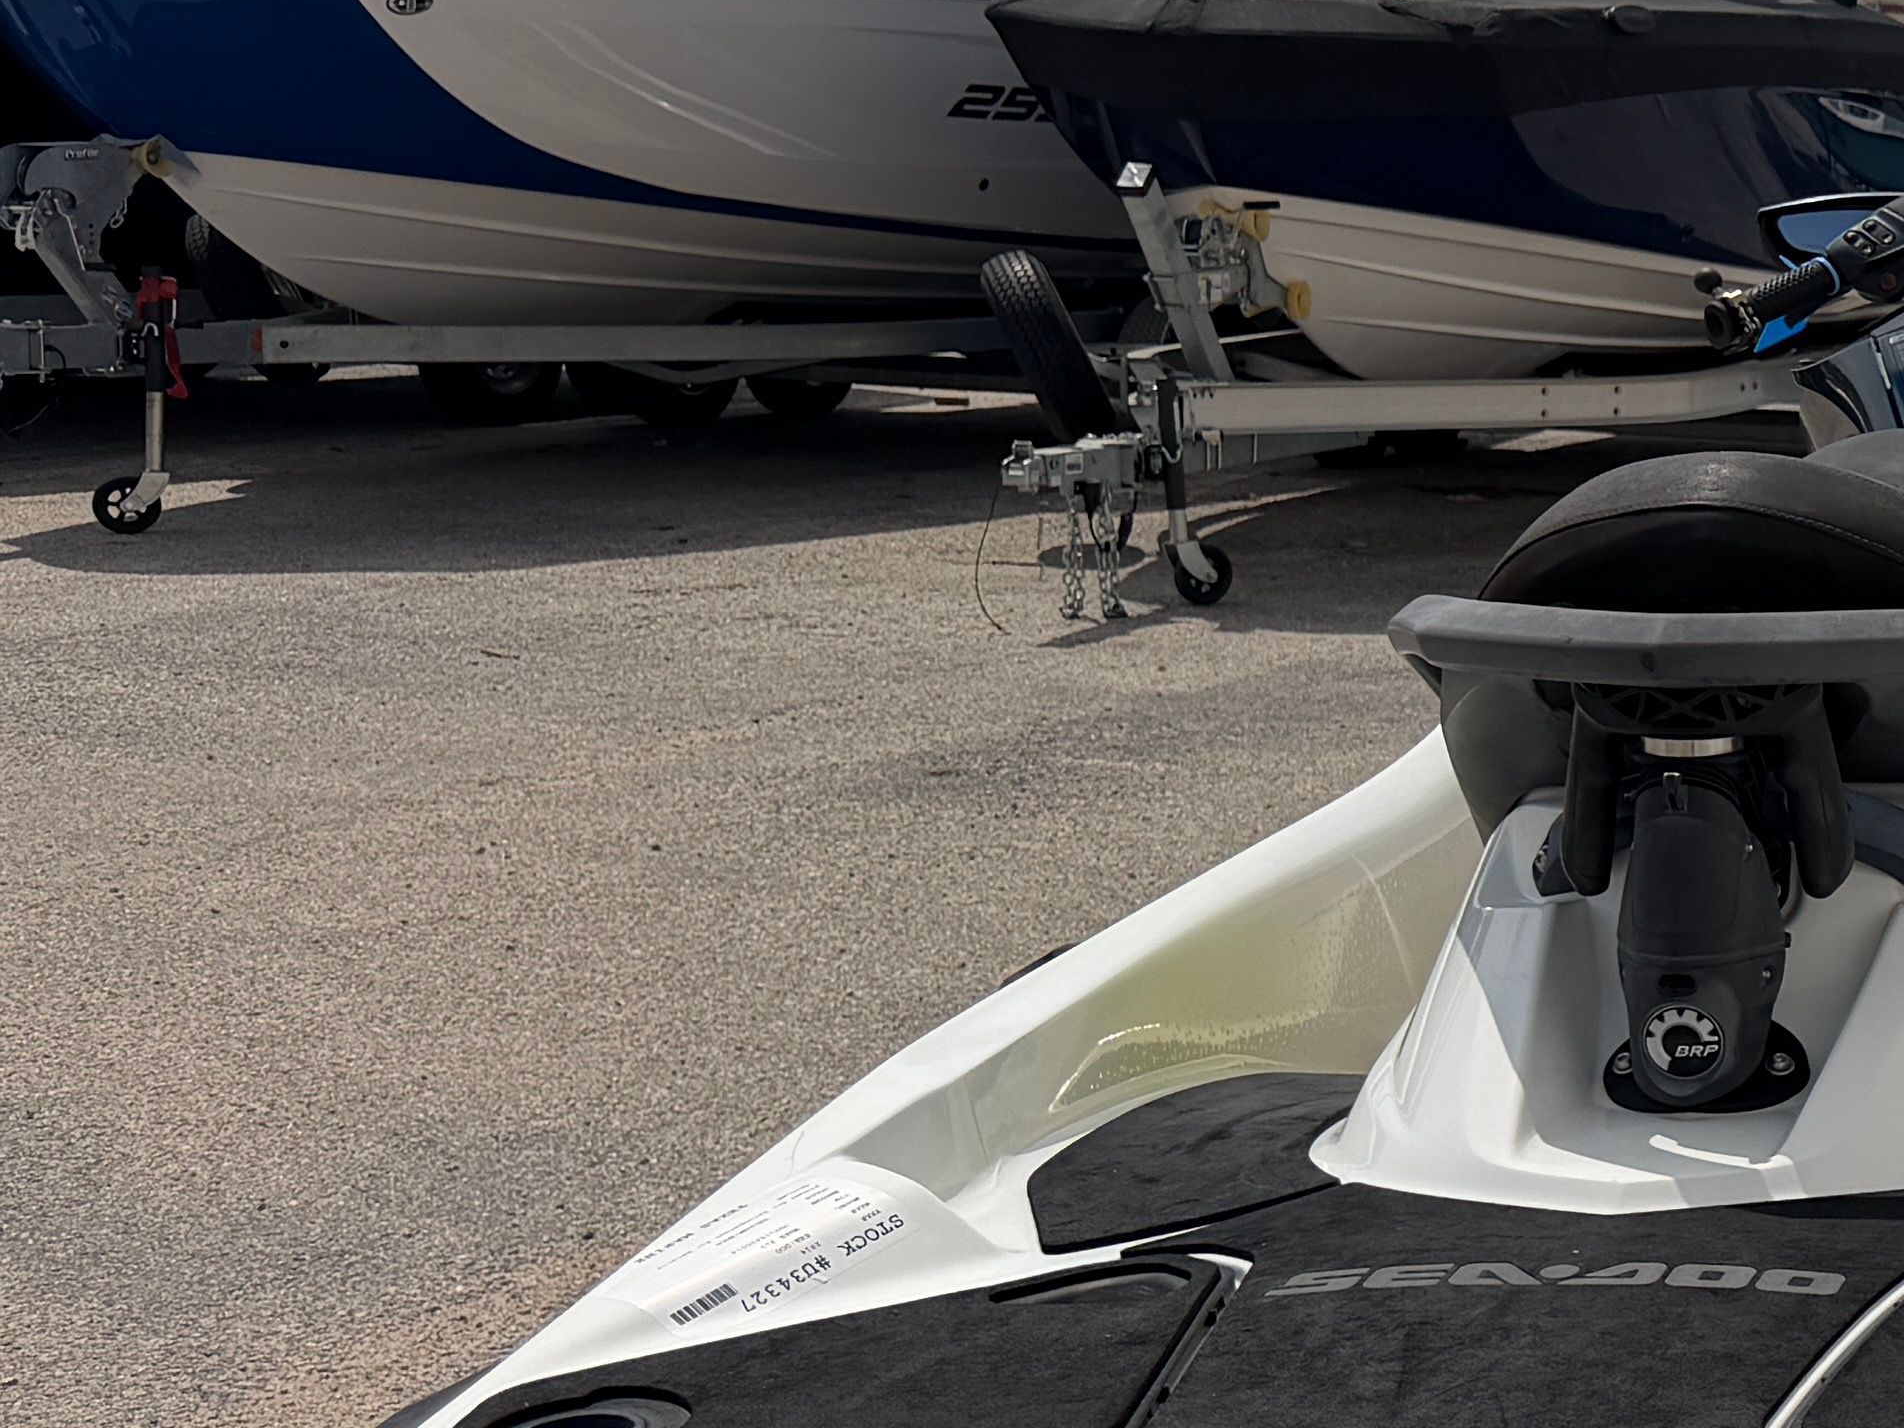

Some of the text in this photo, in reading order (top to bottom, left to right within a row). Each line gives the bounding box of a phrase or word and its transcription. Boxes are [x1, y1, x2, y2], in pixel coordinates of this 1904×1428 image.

[947, 84, 1055, 123] 25
[1675, 1044, 1719, 1057] BRP
[836, 1213, 905, 1257] STOCK
[741, 1254, 832, 1313] #U34327
